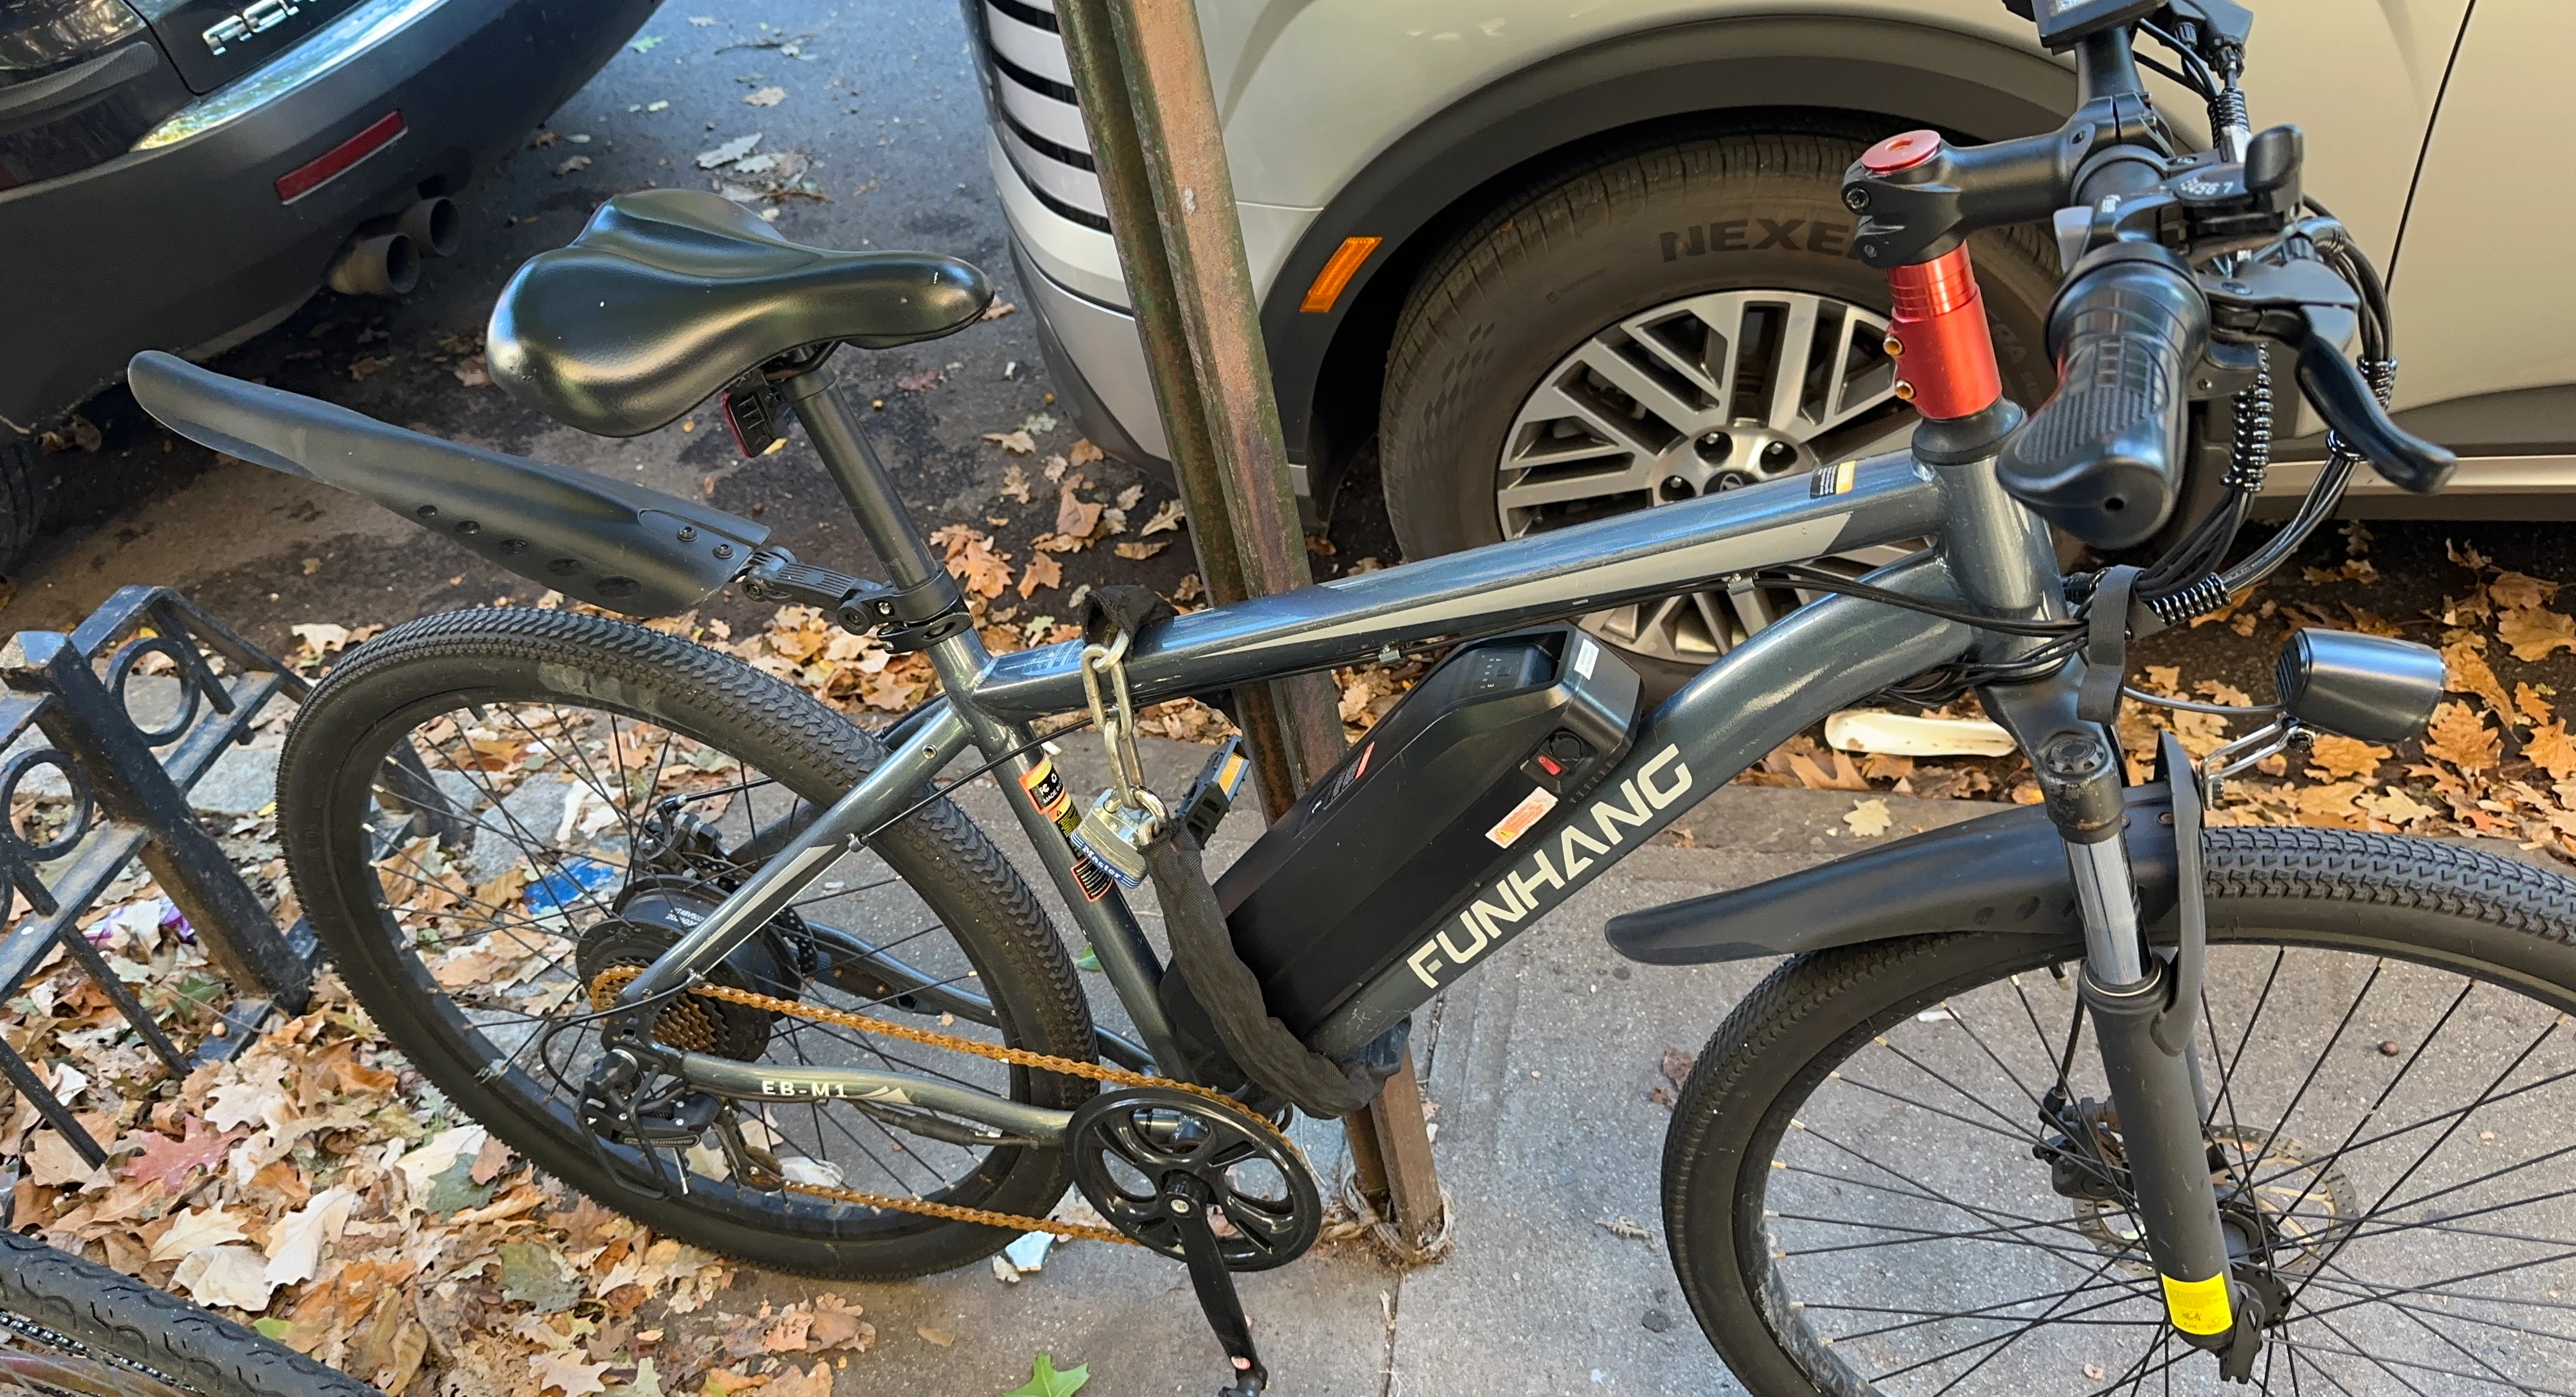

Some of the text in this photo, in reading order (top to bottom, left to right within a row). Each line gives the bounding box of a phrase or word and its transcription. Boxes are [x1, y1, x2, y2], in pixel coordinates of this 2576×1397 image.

[1659, 218, 1860, 263] NEXE
[1043, 789, 1058, 804] MADE
[1082, 845, 1121, 879] Master
[1407, 743, 1692, 989] FUNHANG
[762, 1080, 848, 1098] EB-M1
